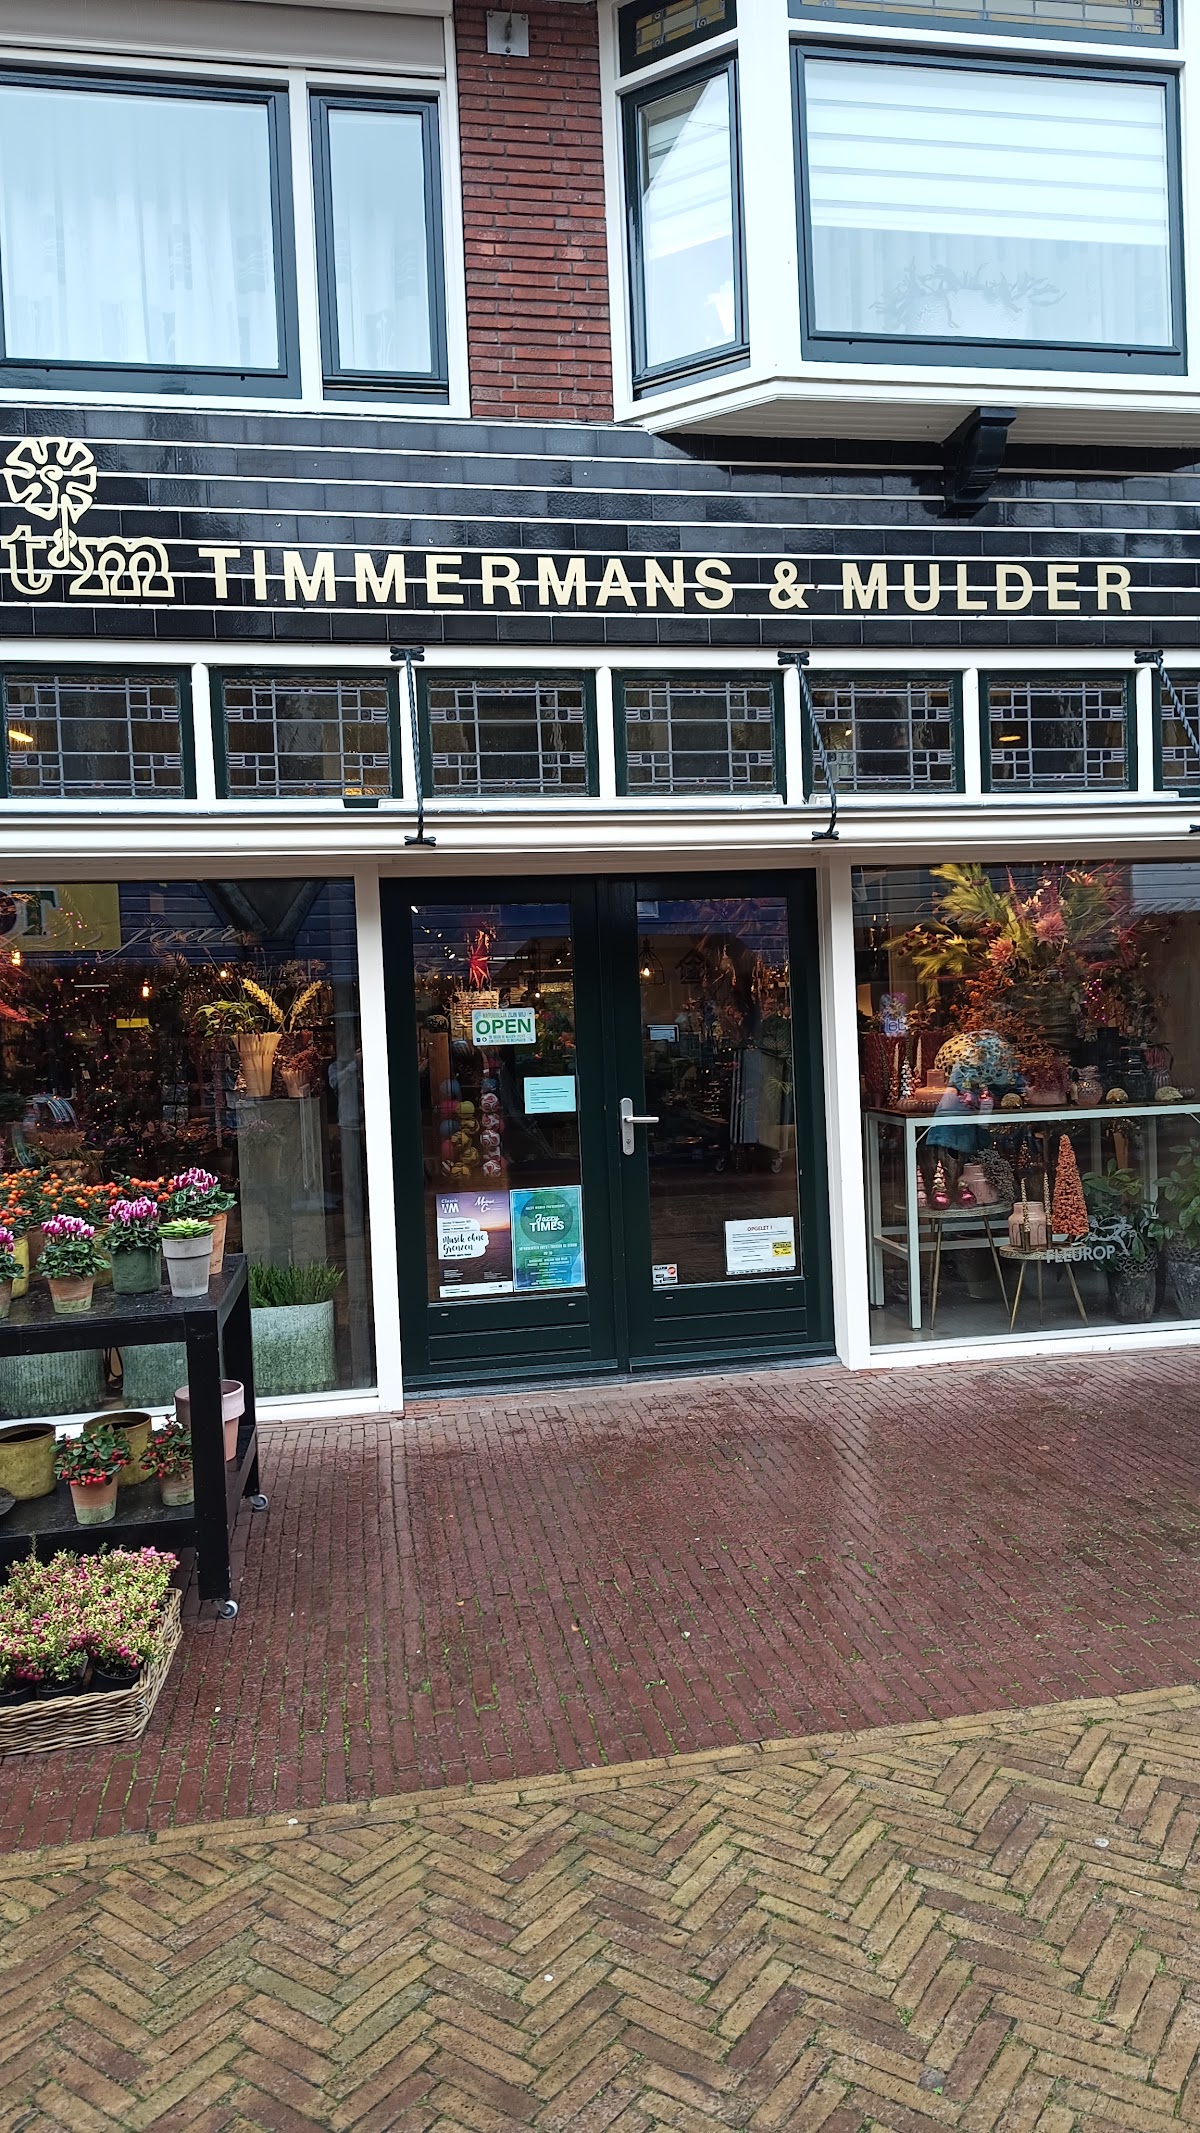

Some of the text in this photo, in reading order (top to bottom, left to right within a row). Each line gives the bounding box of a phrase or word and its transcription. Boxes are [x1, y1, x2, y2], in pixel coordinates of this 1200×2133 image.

[198, 547, 1133, 611] TIMMERMANS & MULDER
[475, 1018, 532, 1035] OPEN
[529, 1220, 565, 1232] TIMES
[442, 1233, 465, 1245] Musik
[1046, 1244, 1116, 1264] FLEUROP
